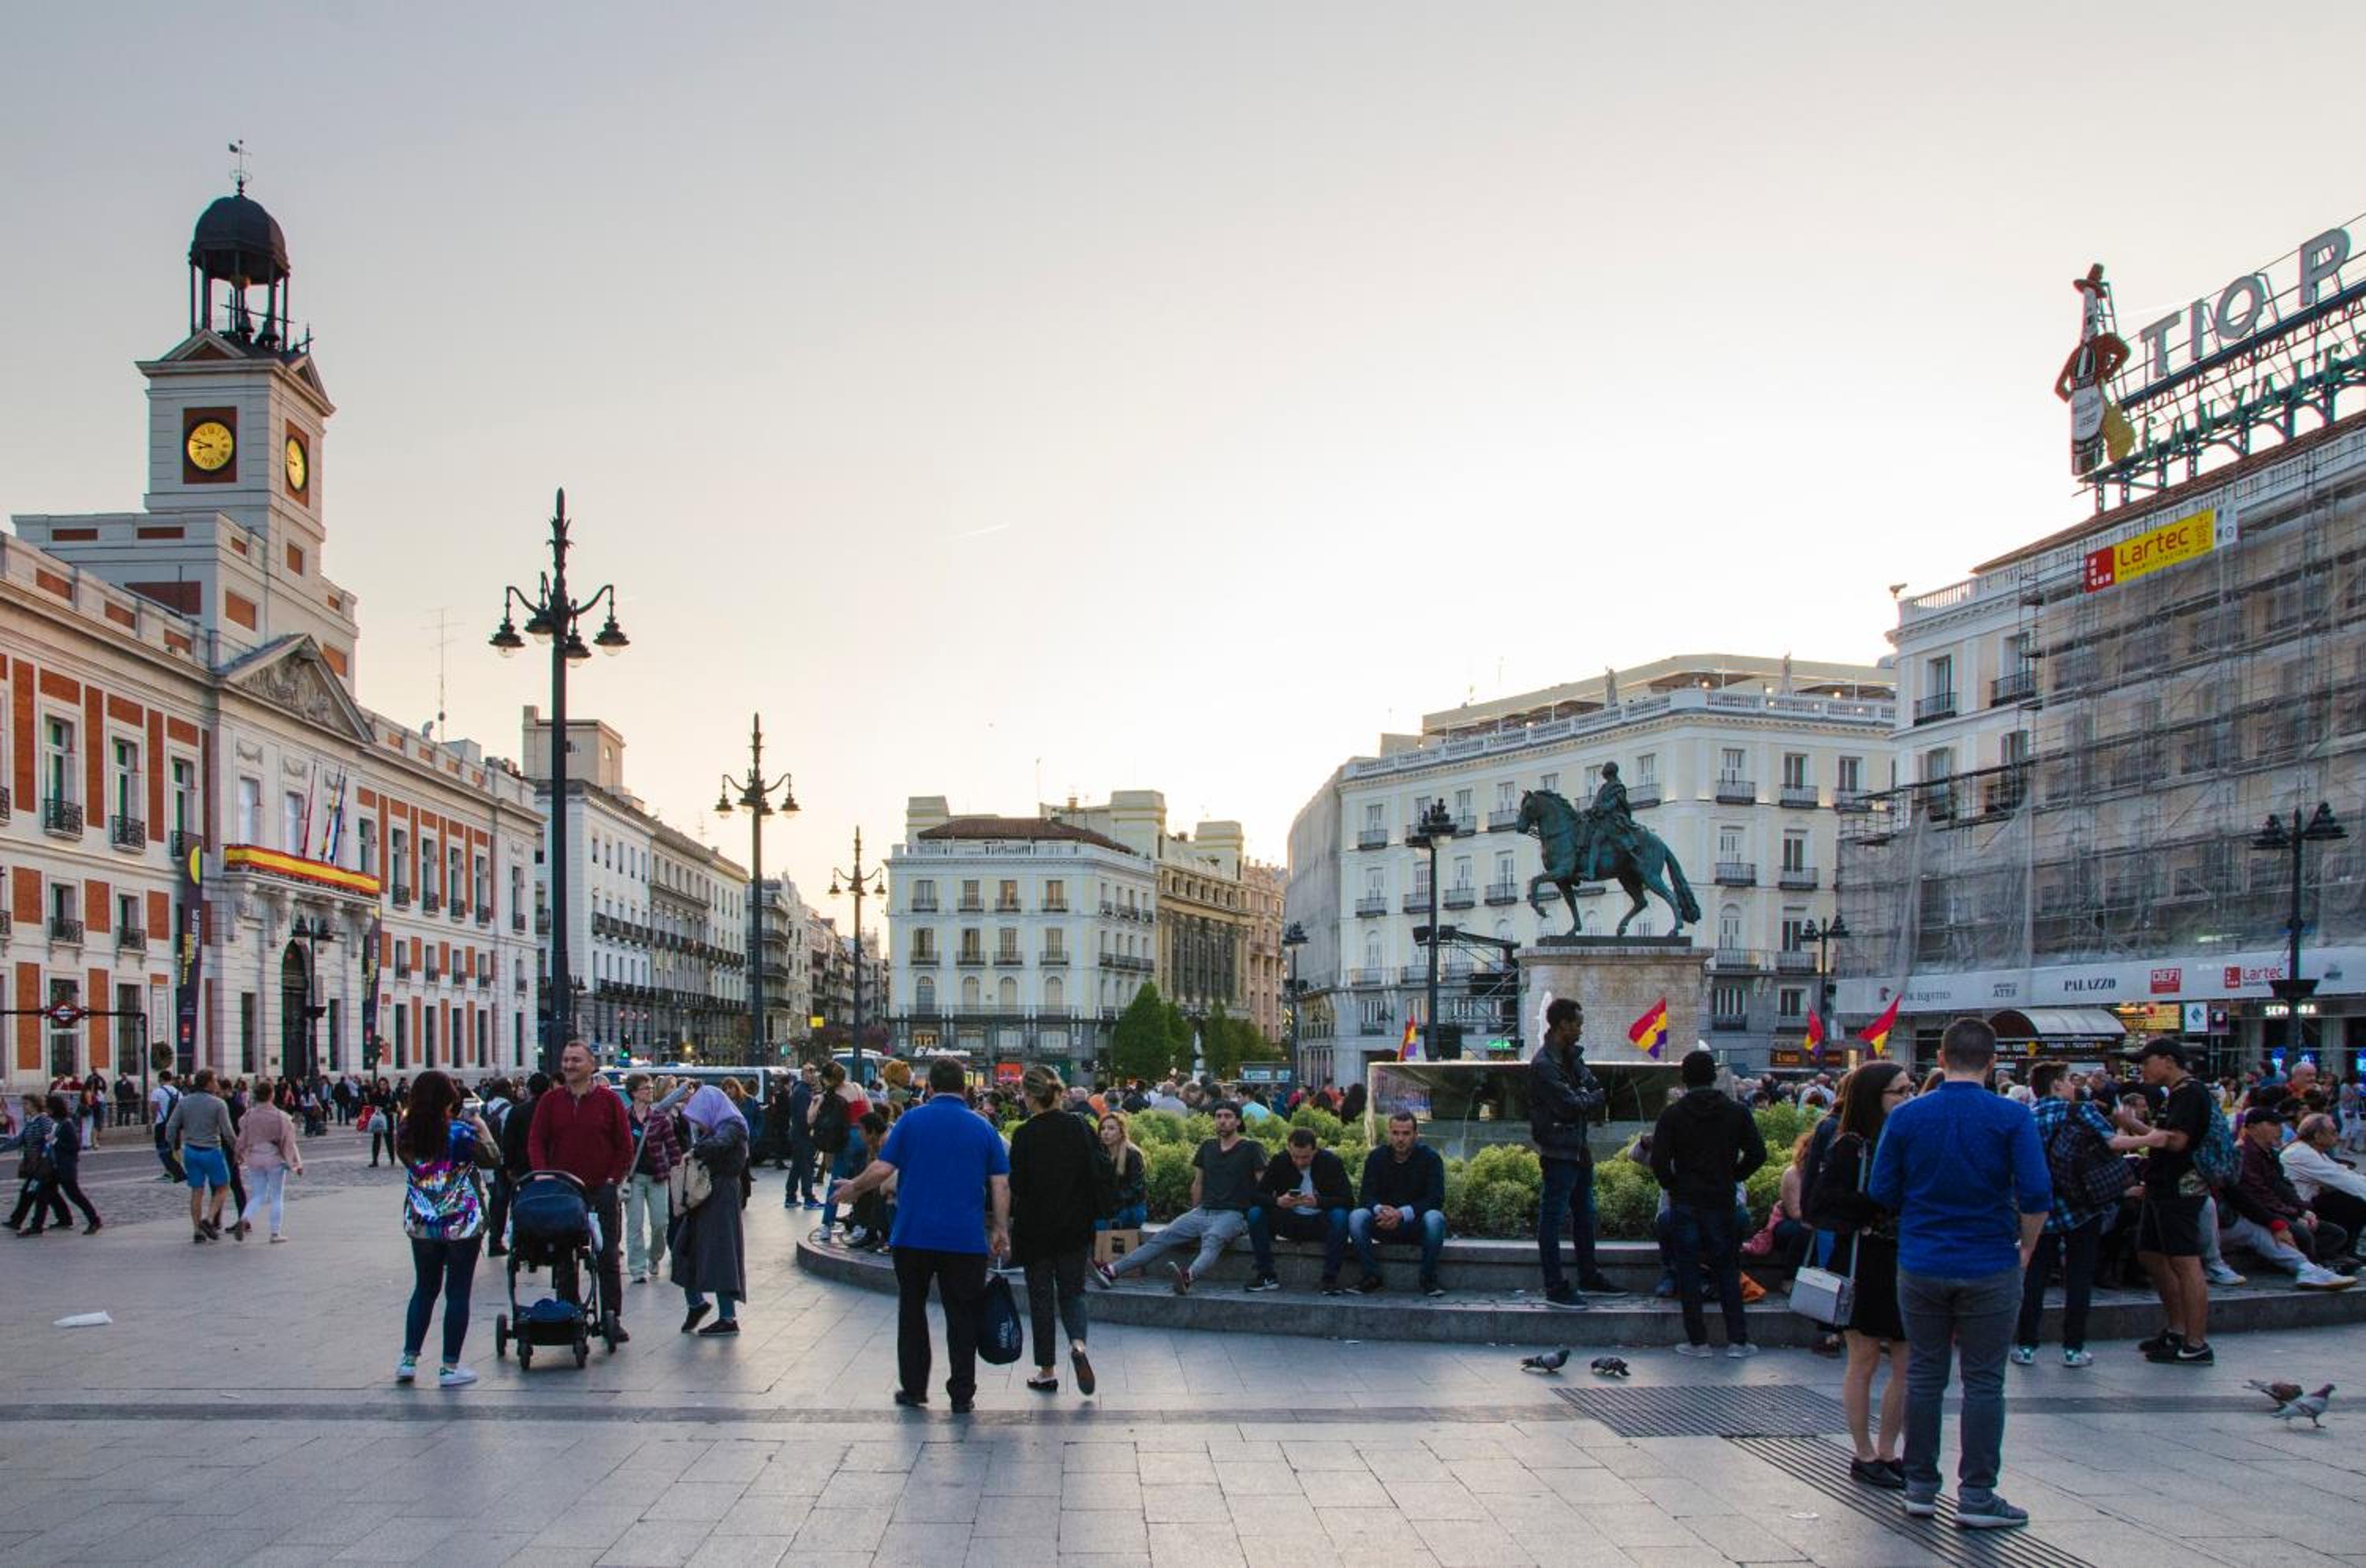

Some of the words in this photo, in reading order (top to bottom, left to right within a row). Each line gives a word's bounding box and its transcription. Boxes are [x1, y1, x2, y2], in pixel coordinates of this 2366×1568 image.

[2139, 274, 2265, 379] TIO
[2119, 526, 2189, 567] Lartec
[2152, 969, 2180, 982] DEFI
[2242, 967, 2283, 981] Lartec
[2064, 977, 2117, 992] PALAZZO
[2264, 1004, 2317, 1017] SEPRA
